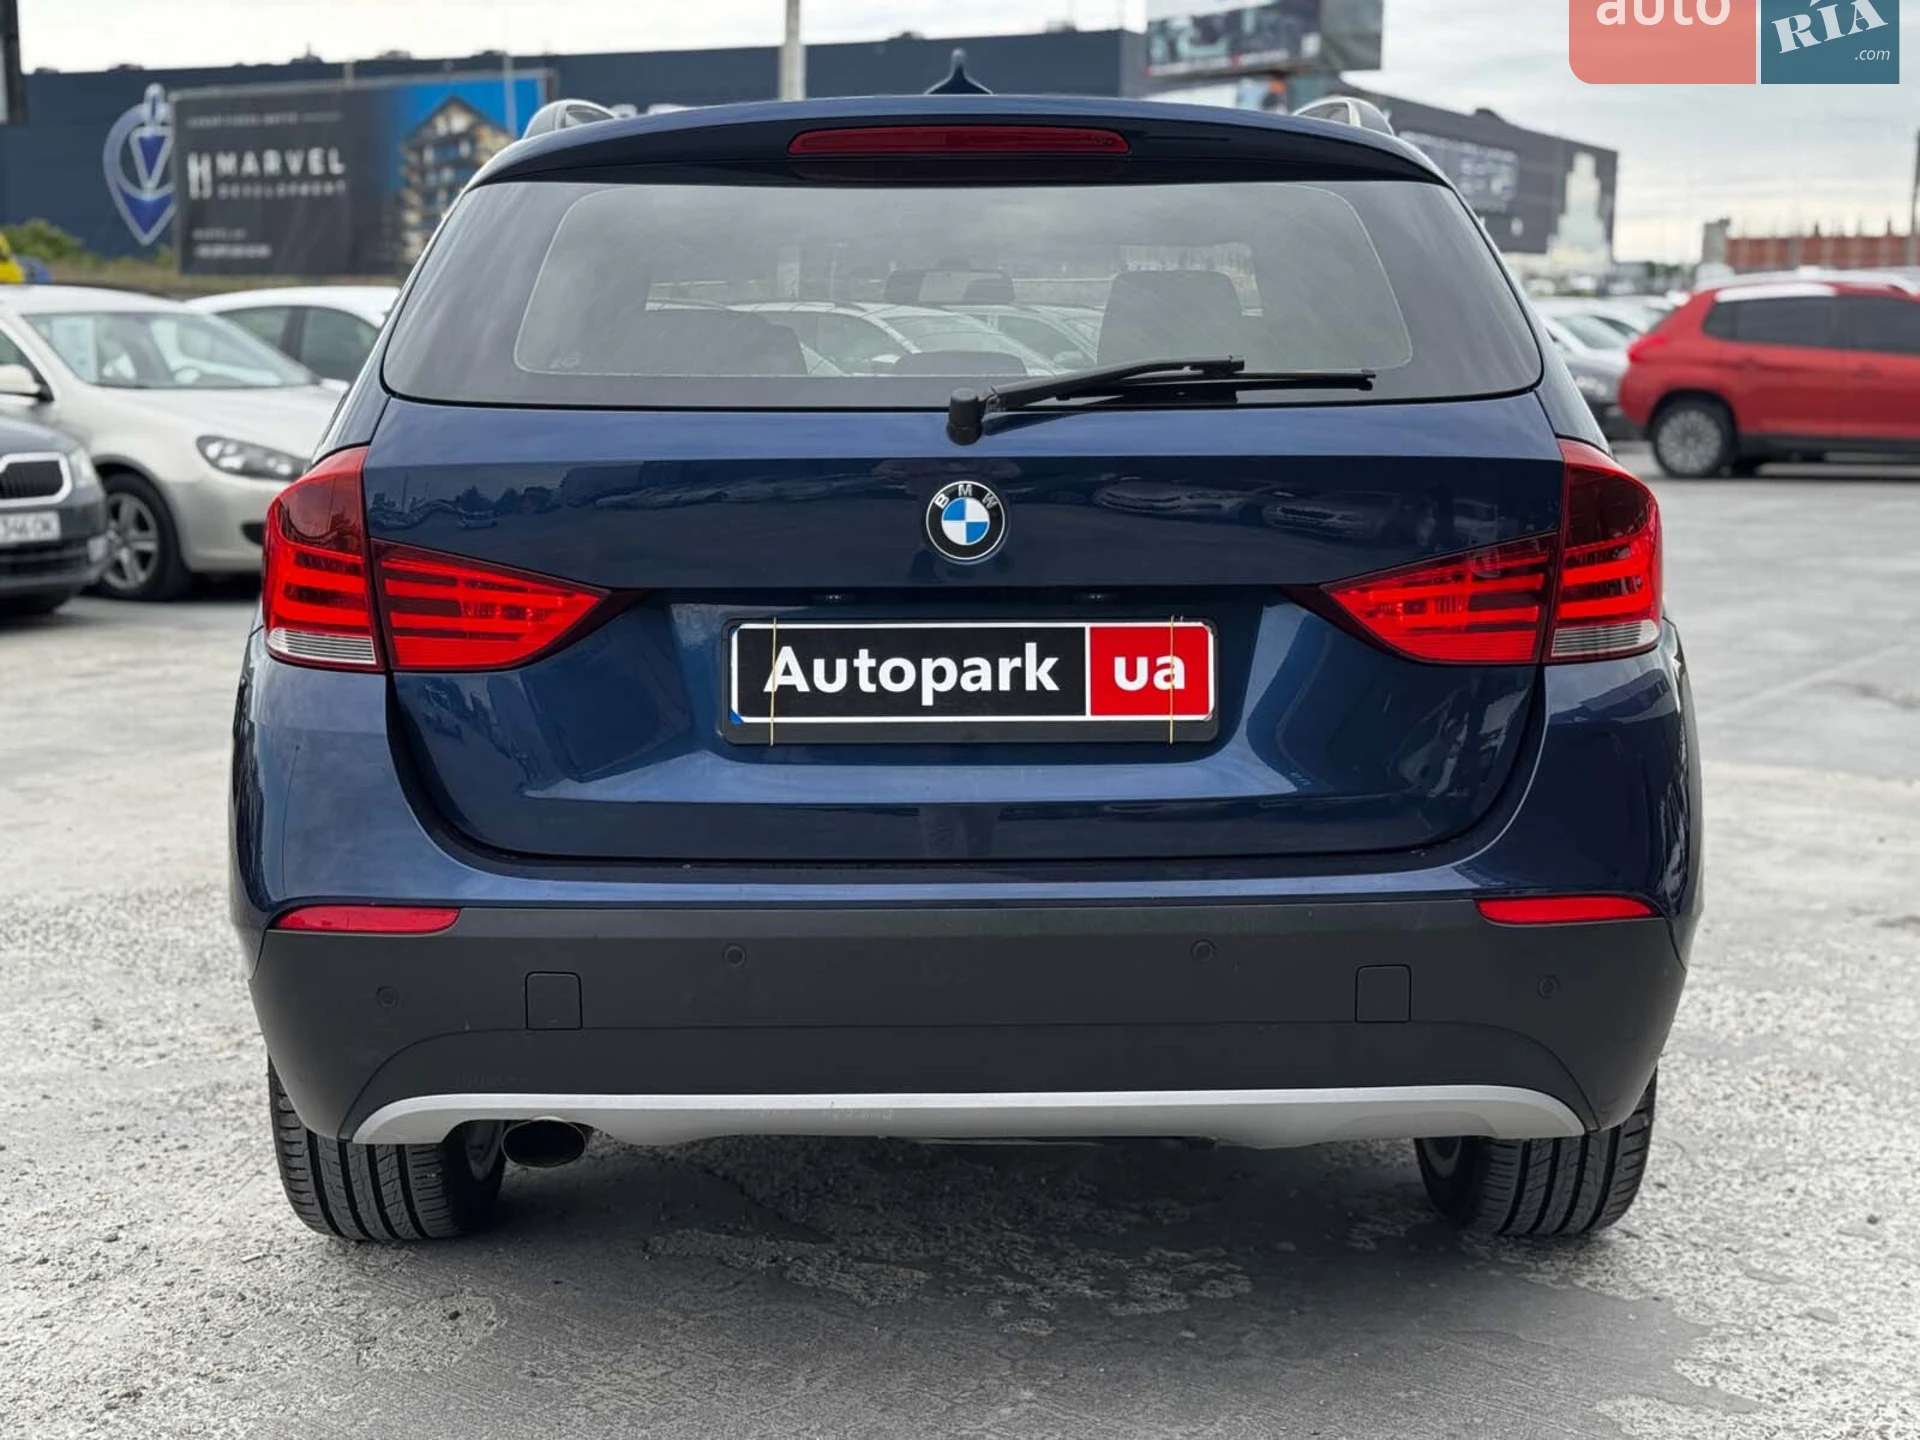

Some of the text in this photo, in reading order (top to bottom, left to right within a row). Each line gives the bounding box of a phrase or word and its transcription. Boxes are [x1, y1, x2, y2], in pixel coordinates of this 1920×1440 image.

[215, 147, 346, 178] MARVEL
[934, 484, 998, 509] BMW
[763, 642, 1186, 706] Autopark ua
